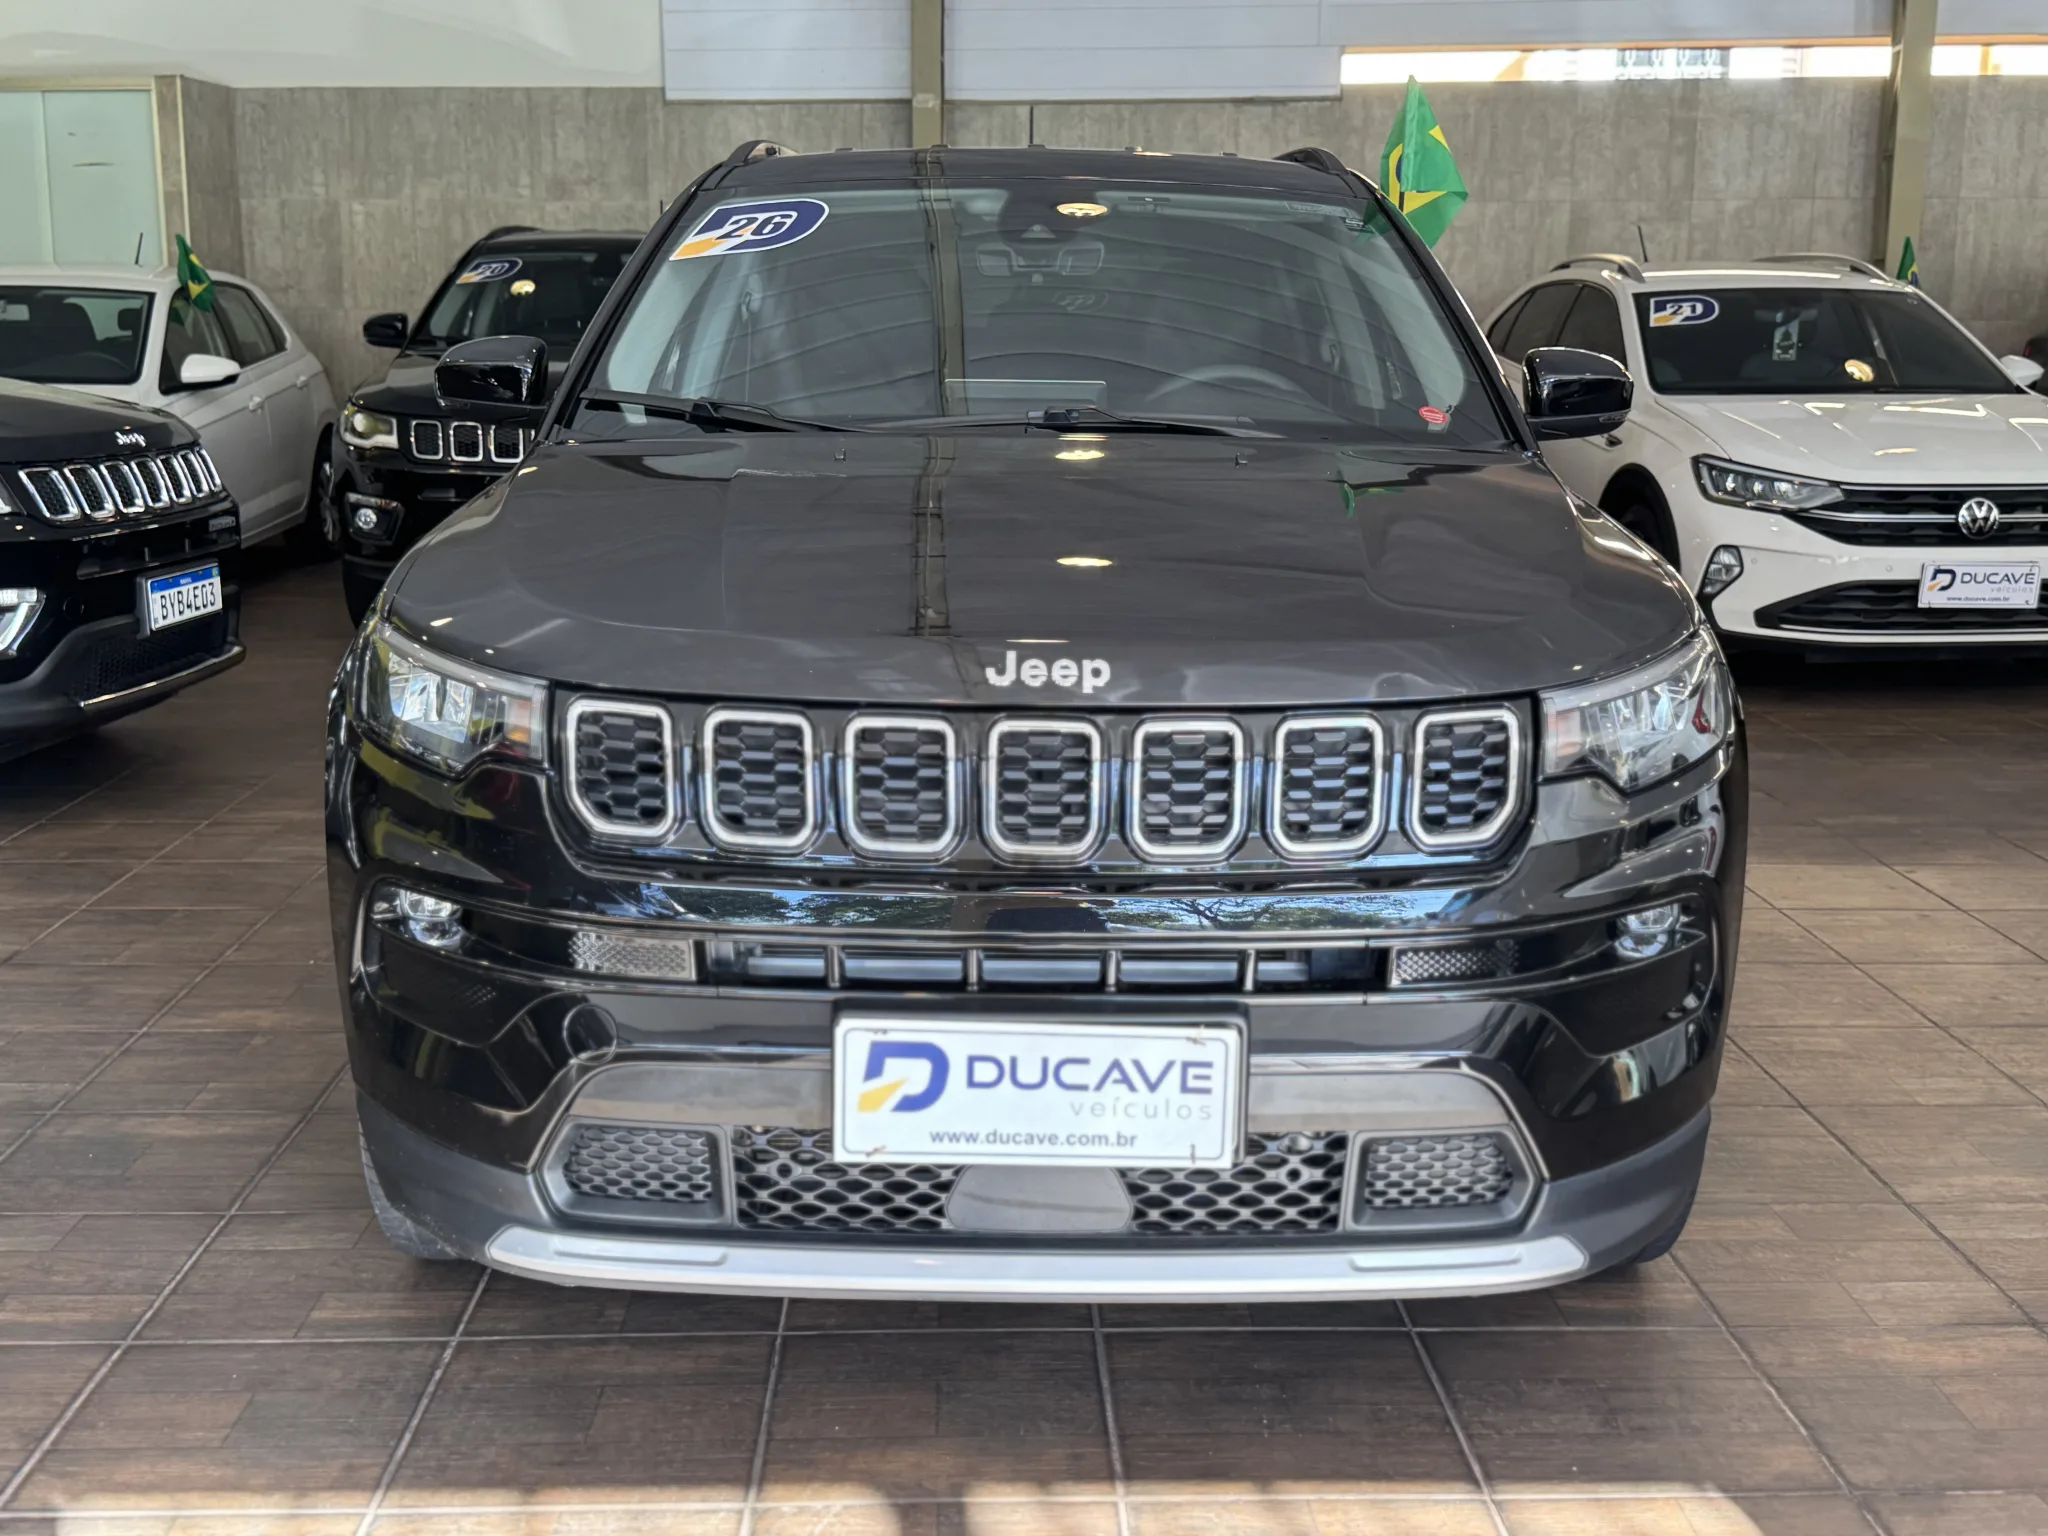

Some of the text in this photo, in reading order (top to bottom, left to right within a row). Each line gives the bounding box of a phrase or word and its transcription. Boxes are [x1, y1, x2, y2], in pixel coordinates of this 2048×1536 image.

[715, 213, 793, 240] 26
[1668, 303, 1697, 316] 21
[1960, 572, 2036, 585] DUCAVE
[160, 582, 216, 621] BYB4E03
[985, 650, 1111, 694] Jeep
[966, 1054, 1213, 1095] DUCAVE
[1069, 1099, 1213, 1121] veículos
[929, 1128, 1137, 1149] www.ducave.com.br
